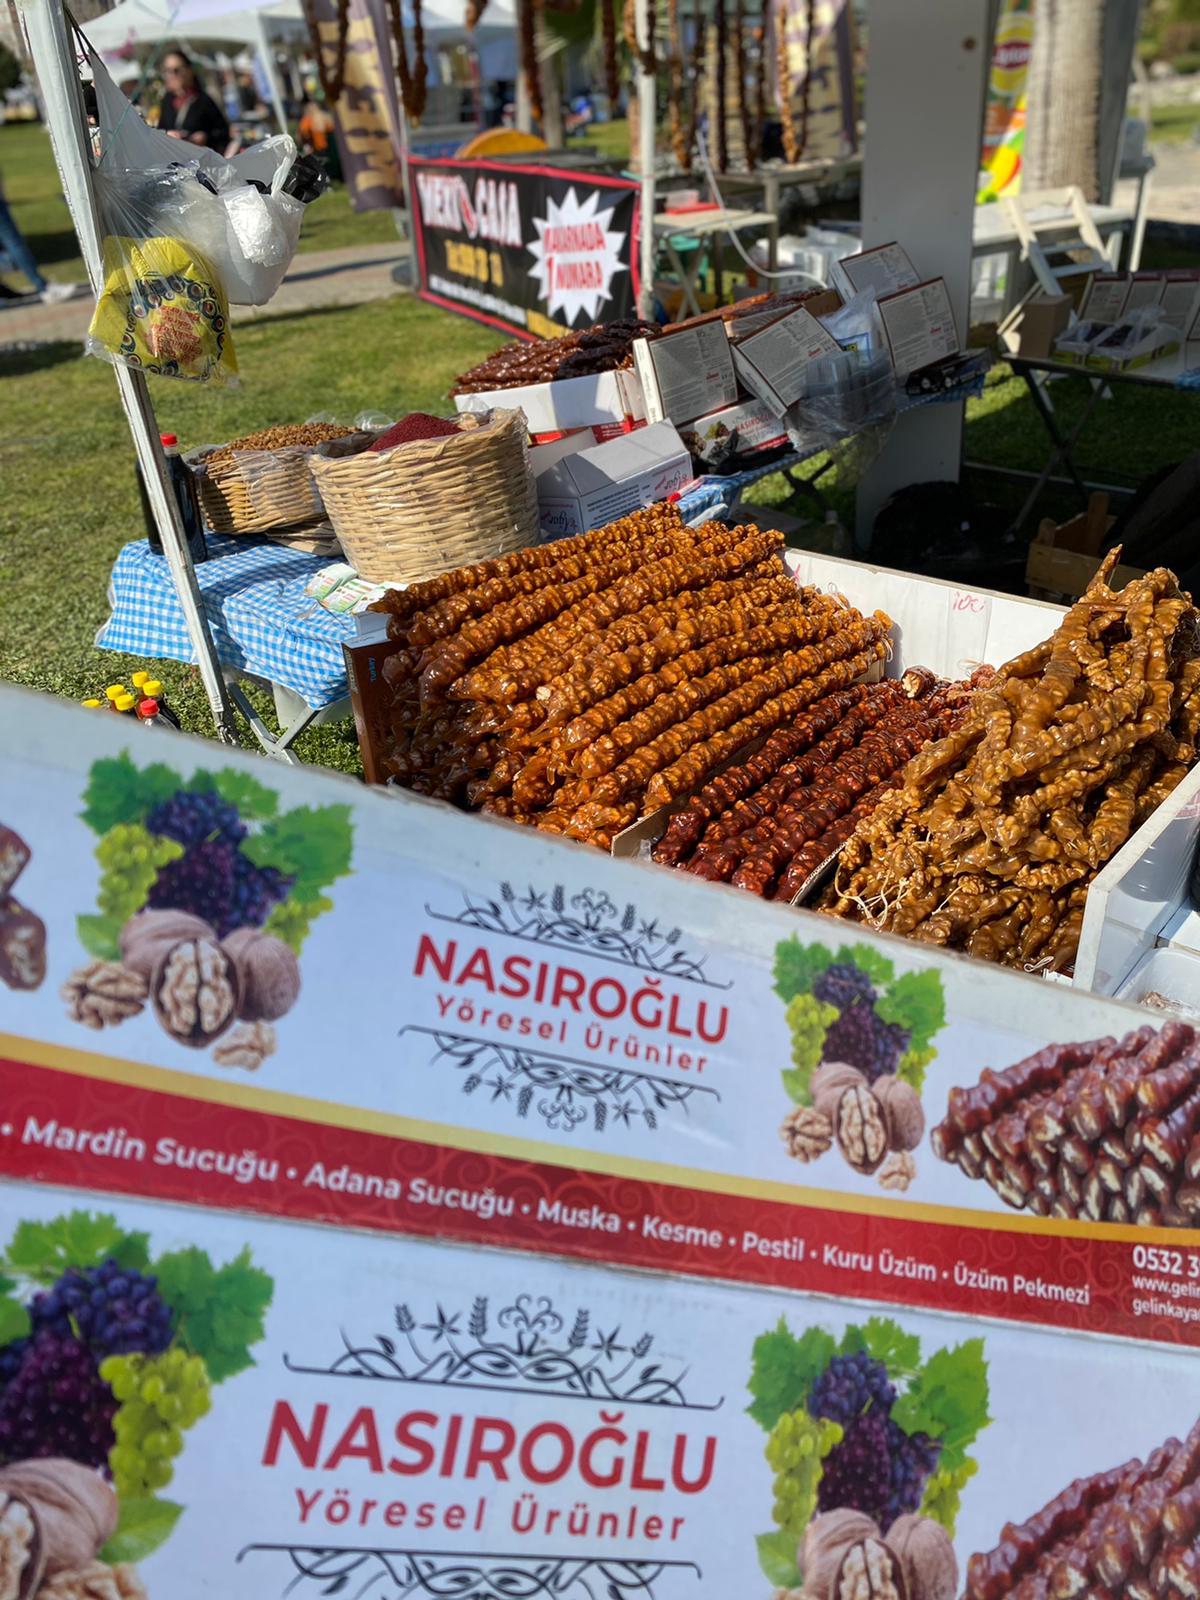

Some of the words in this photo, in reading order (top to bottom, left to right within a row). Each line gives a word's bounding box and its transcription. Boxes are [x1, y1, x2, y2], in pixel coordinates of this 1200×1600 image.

[413, 934, 729, 1043] NASIROĞLU
[436, 994, 567, 1042] Yöresel
[585, 1023, 708, 1073] Ürünler
[22, 1116, 146, 1161] Mardin
[153, 1137, 279, 1184] Sucuğu
[303, 1162, 400, 1200] Adana
[407, 1178, 514, 1218] Sucuğu
[537, 1199, 621, 1233] Muska
[642, 1215, 723, 1248] Kesme
[742, 1231, 805, 1261] Pestil
[823, 1244, 873, 1272] Kuru
[879, 1248, 936, 1281] Üzüm
[954, 1261, 1008, 1292] Üzüm
[1013, 1275, 1090, 1305] Pekmezi
[1133, 1245, 1182, 1275] 0532
[1187, 1254, 1200, 1278] 3
[262, 1399, 718, 1494] NASIROĞLU
[295, 1488, 485, 1532] Yöresel
[511, 1493, 685, 1542] Ürünler
